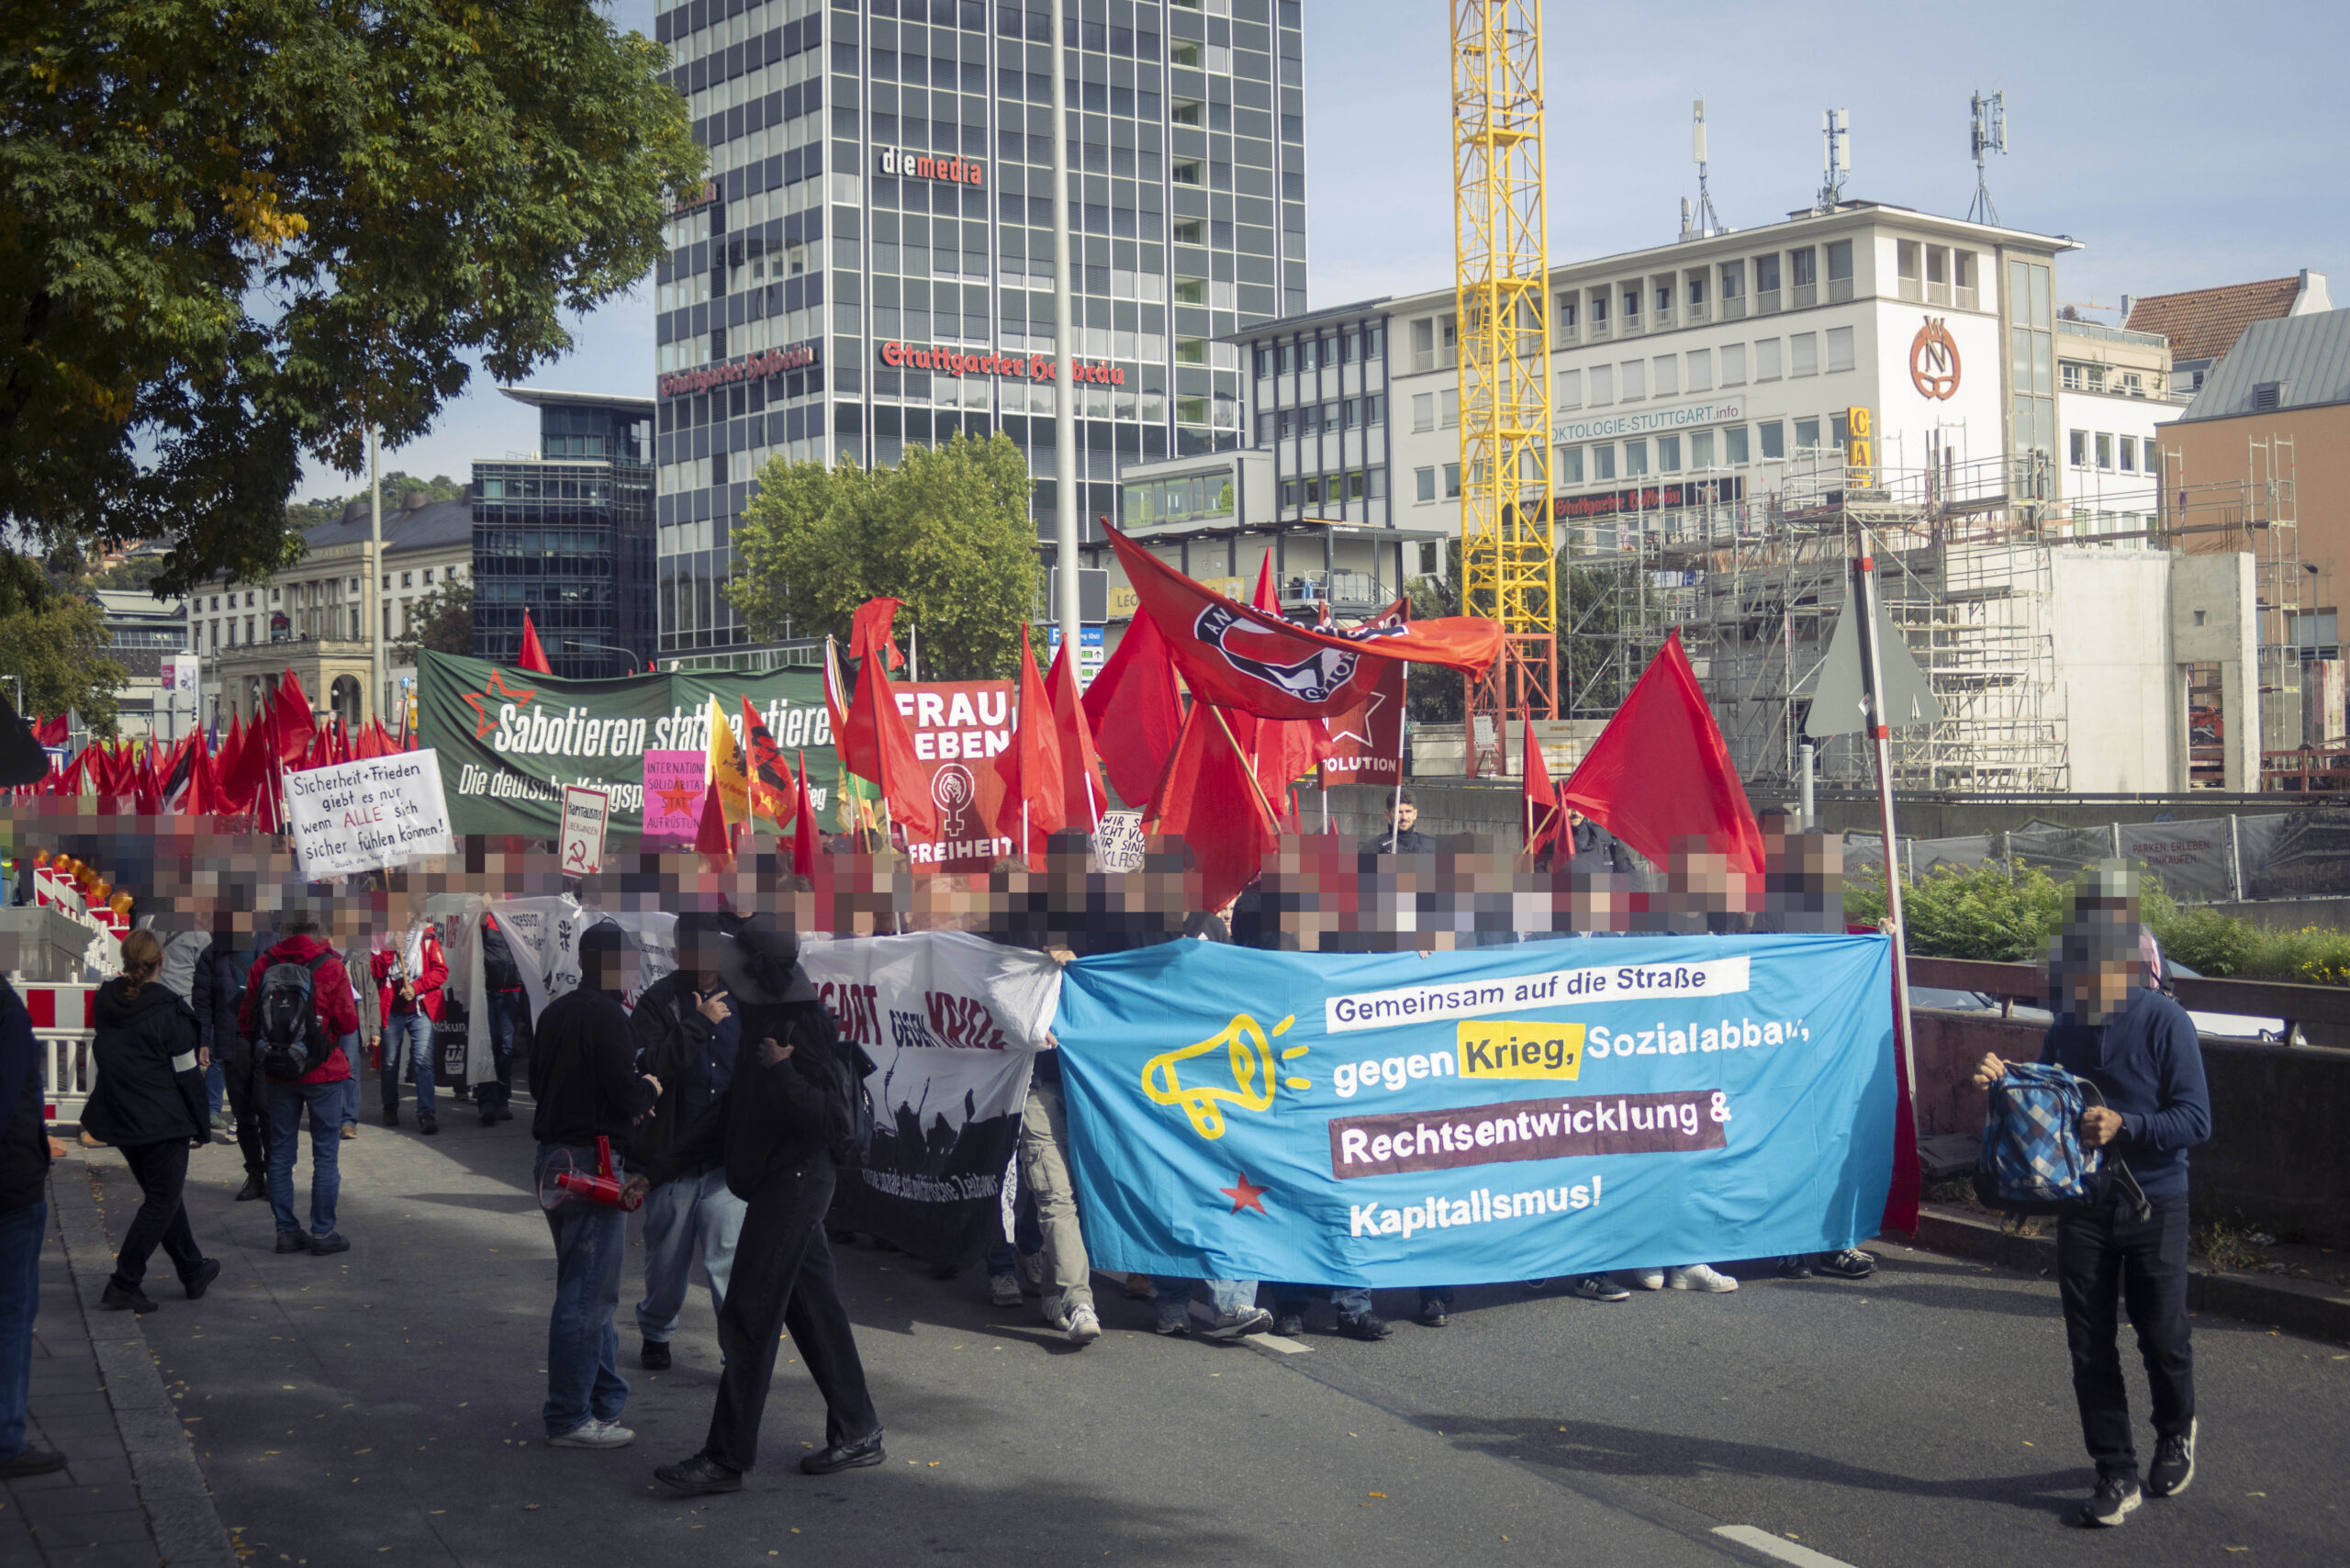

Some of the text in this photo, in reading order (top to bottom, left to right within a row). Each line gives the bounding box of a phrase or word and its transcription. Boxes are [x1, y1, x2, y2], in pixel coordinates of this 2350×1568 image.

[660, 343, 814, 397] Stuttgarter Hofbräu
[881, 340, 1125, 386] Stuttgarter Hobräu
[1555, 494, 1625, 516] Stuttgarter
[894, 690, 1007, 728] FRAU
[494, 703, 647, 757] Sabotieren
[914, 730, 1011, 761] EBEN
[294, 769, 362, 797] Sicherheit
[369, 764, 420, 781] Frieden
[458, 764, 488, 796] Die
[1322, 756, 1396, 772] OLUTION
[322, 787, 402, 812] giebt es nur
[661, 797, 694, 809] STATT
[301, 800, 419, 835] wenn ALLE sich
[646, 815, 700, 829] AUFRÜSTUN
[1099, 825, 1125, 837] ICHT
[1103, 816, 1125, 827] WIR
[305, 818, 445, 860] sicher fühlen können!
[907, 836, 1013, 865] FREIHEIT
[1335, 967, 1707, 1023] Gemeinsam auf die Straße
[813, 981, 883, 1046] GART
[1333, 1048, 1454, 1098] gegen
[1465, 1037, 1575, 1073] Krieg,
[1340, 1091, 1733, 1165] Rechtsentwicklung &
[1349, 1175, 1603, 1239] Kapitalismus!
